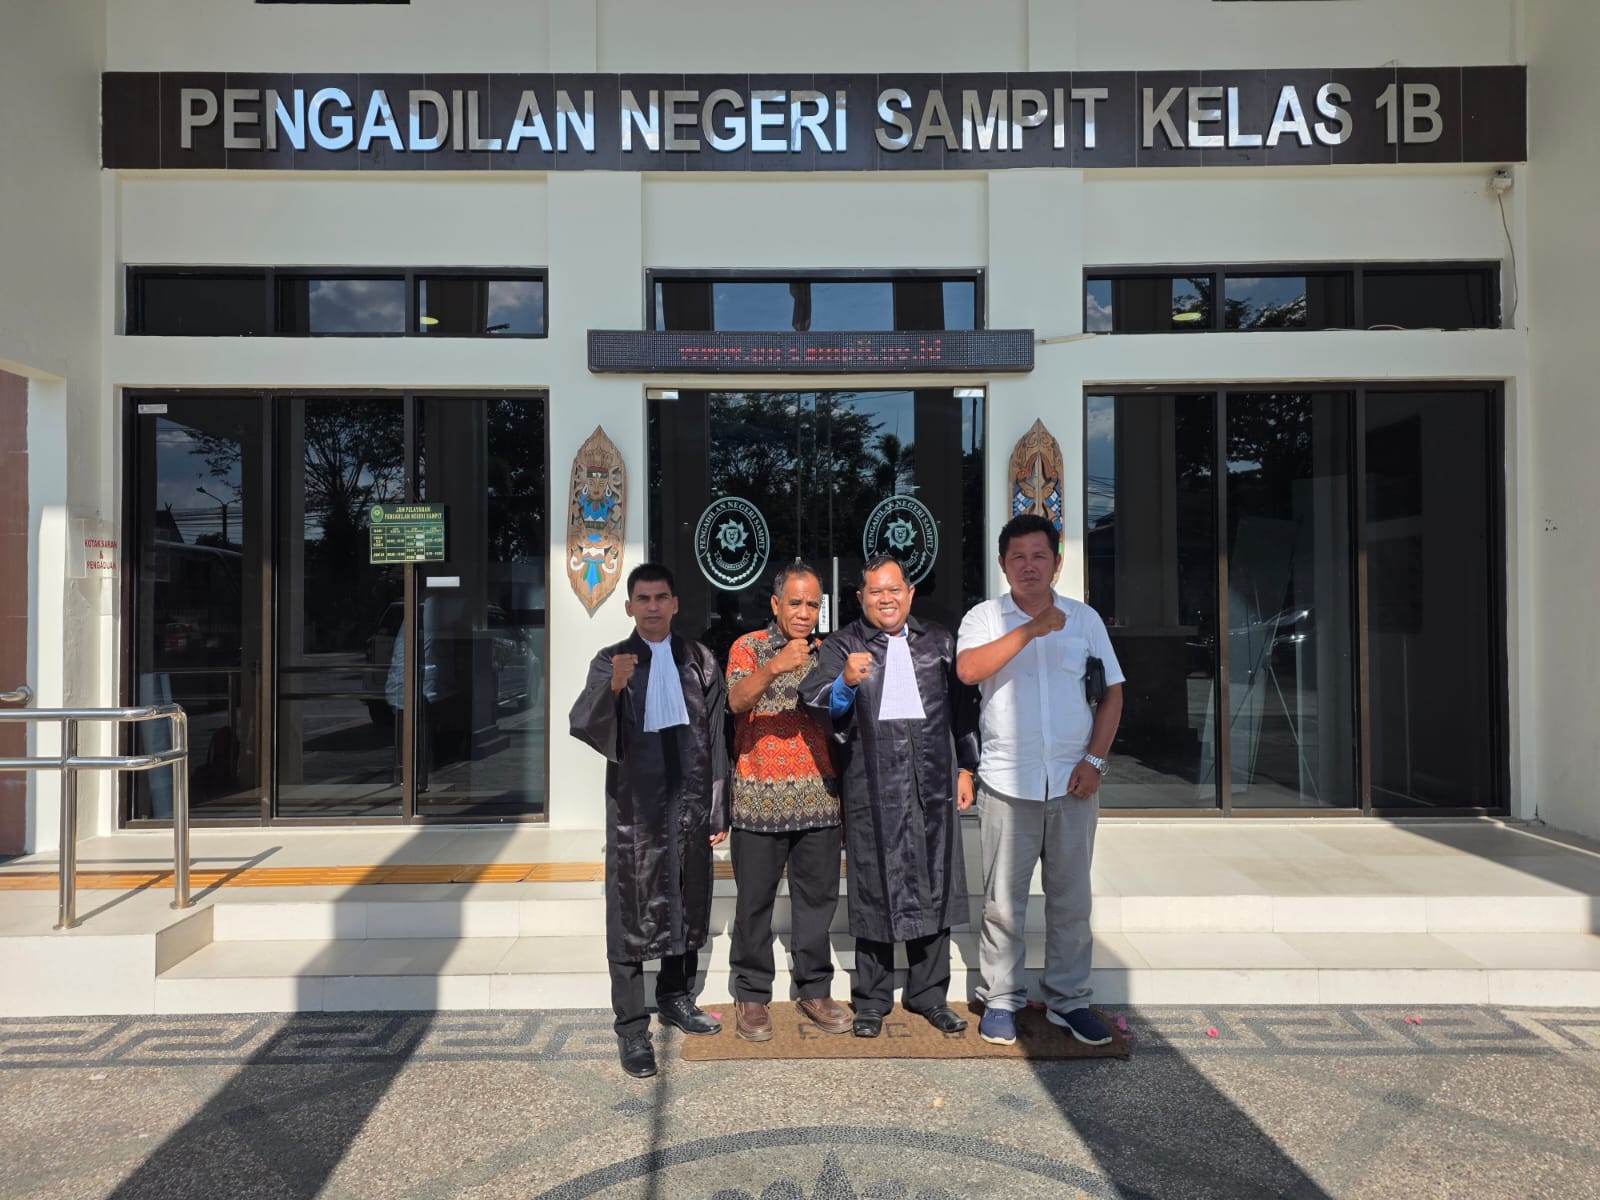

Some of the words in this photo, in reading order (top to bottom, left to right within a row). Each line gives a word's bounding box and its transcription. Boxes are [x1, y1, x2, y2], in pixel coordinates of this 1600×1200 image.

[180, 87, 596, 152] PENGADILAN
[621, 88, 847, 152] NEGERI
[875, 87, 1109, 151] SAMPIT
[1142, 83, 1353, 149] KELAS
[1375, 83, 1443, 145] 1B
[700, 504, 726, 550] PENGADILAN
[727, 501, 757, 520] NEGERI
[753, 519, 766, 550] SAMPIT
[868, 502, 895, 548] PENGADILAN
[895, 500, 926, 519] NEGERI
[922, 517, 934, 548] SAMPIT
